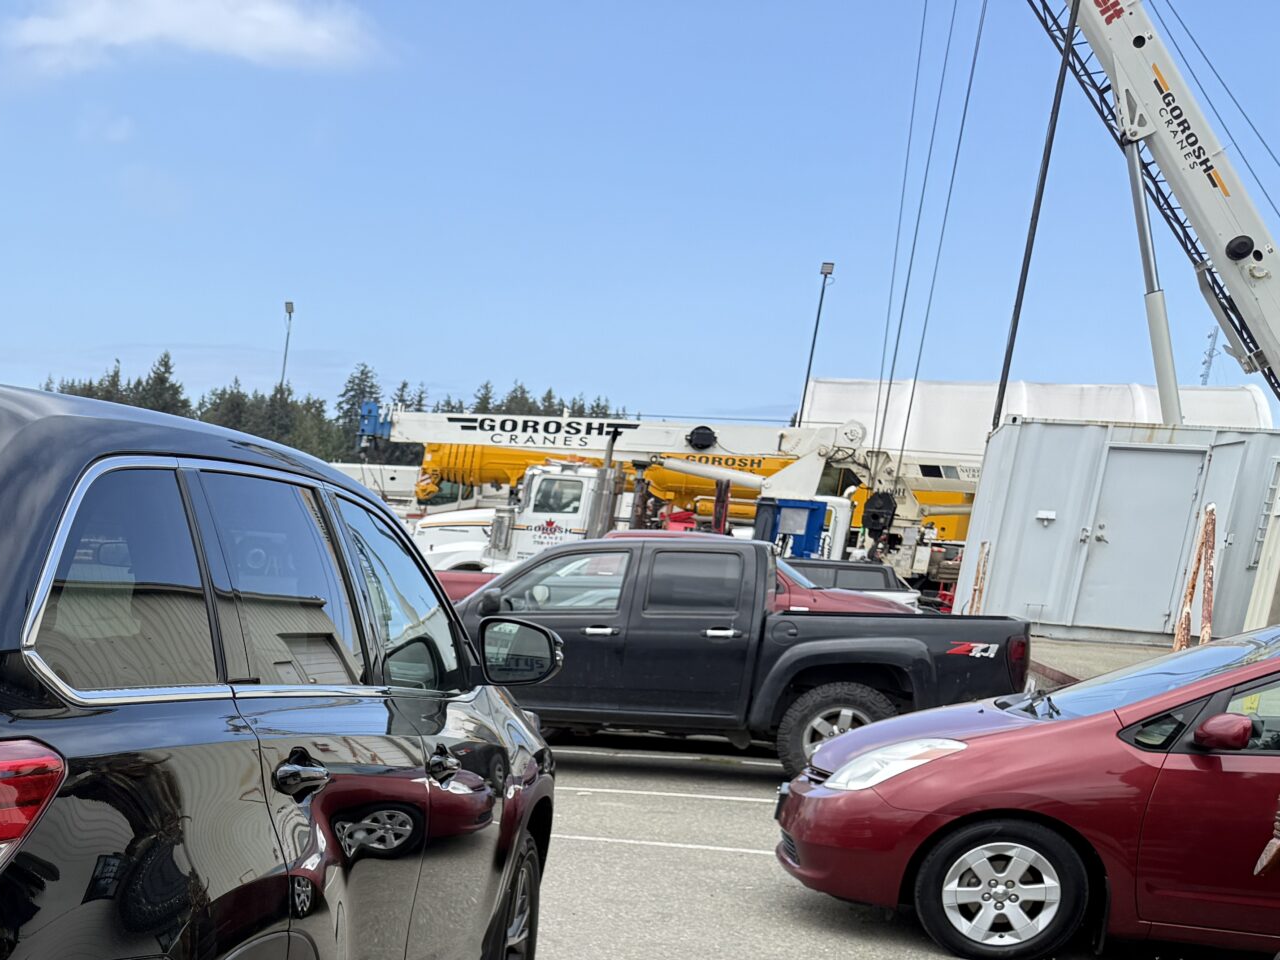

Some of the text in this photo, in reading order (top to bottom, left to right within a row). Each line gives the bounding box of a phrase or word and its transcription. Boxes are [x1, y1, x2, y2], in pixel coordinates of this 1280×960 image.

[1158, 107, 1199, 170] CRANES
[1162, 92, 1215, 174] GOROSH
[479, 417, 605, 437] GOROSH
[490, 433, 588, 447] CRANES
[685, 454, 763, 469] GOROSH
[526, 525, 573, 535] GOROSH
